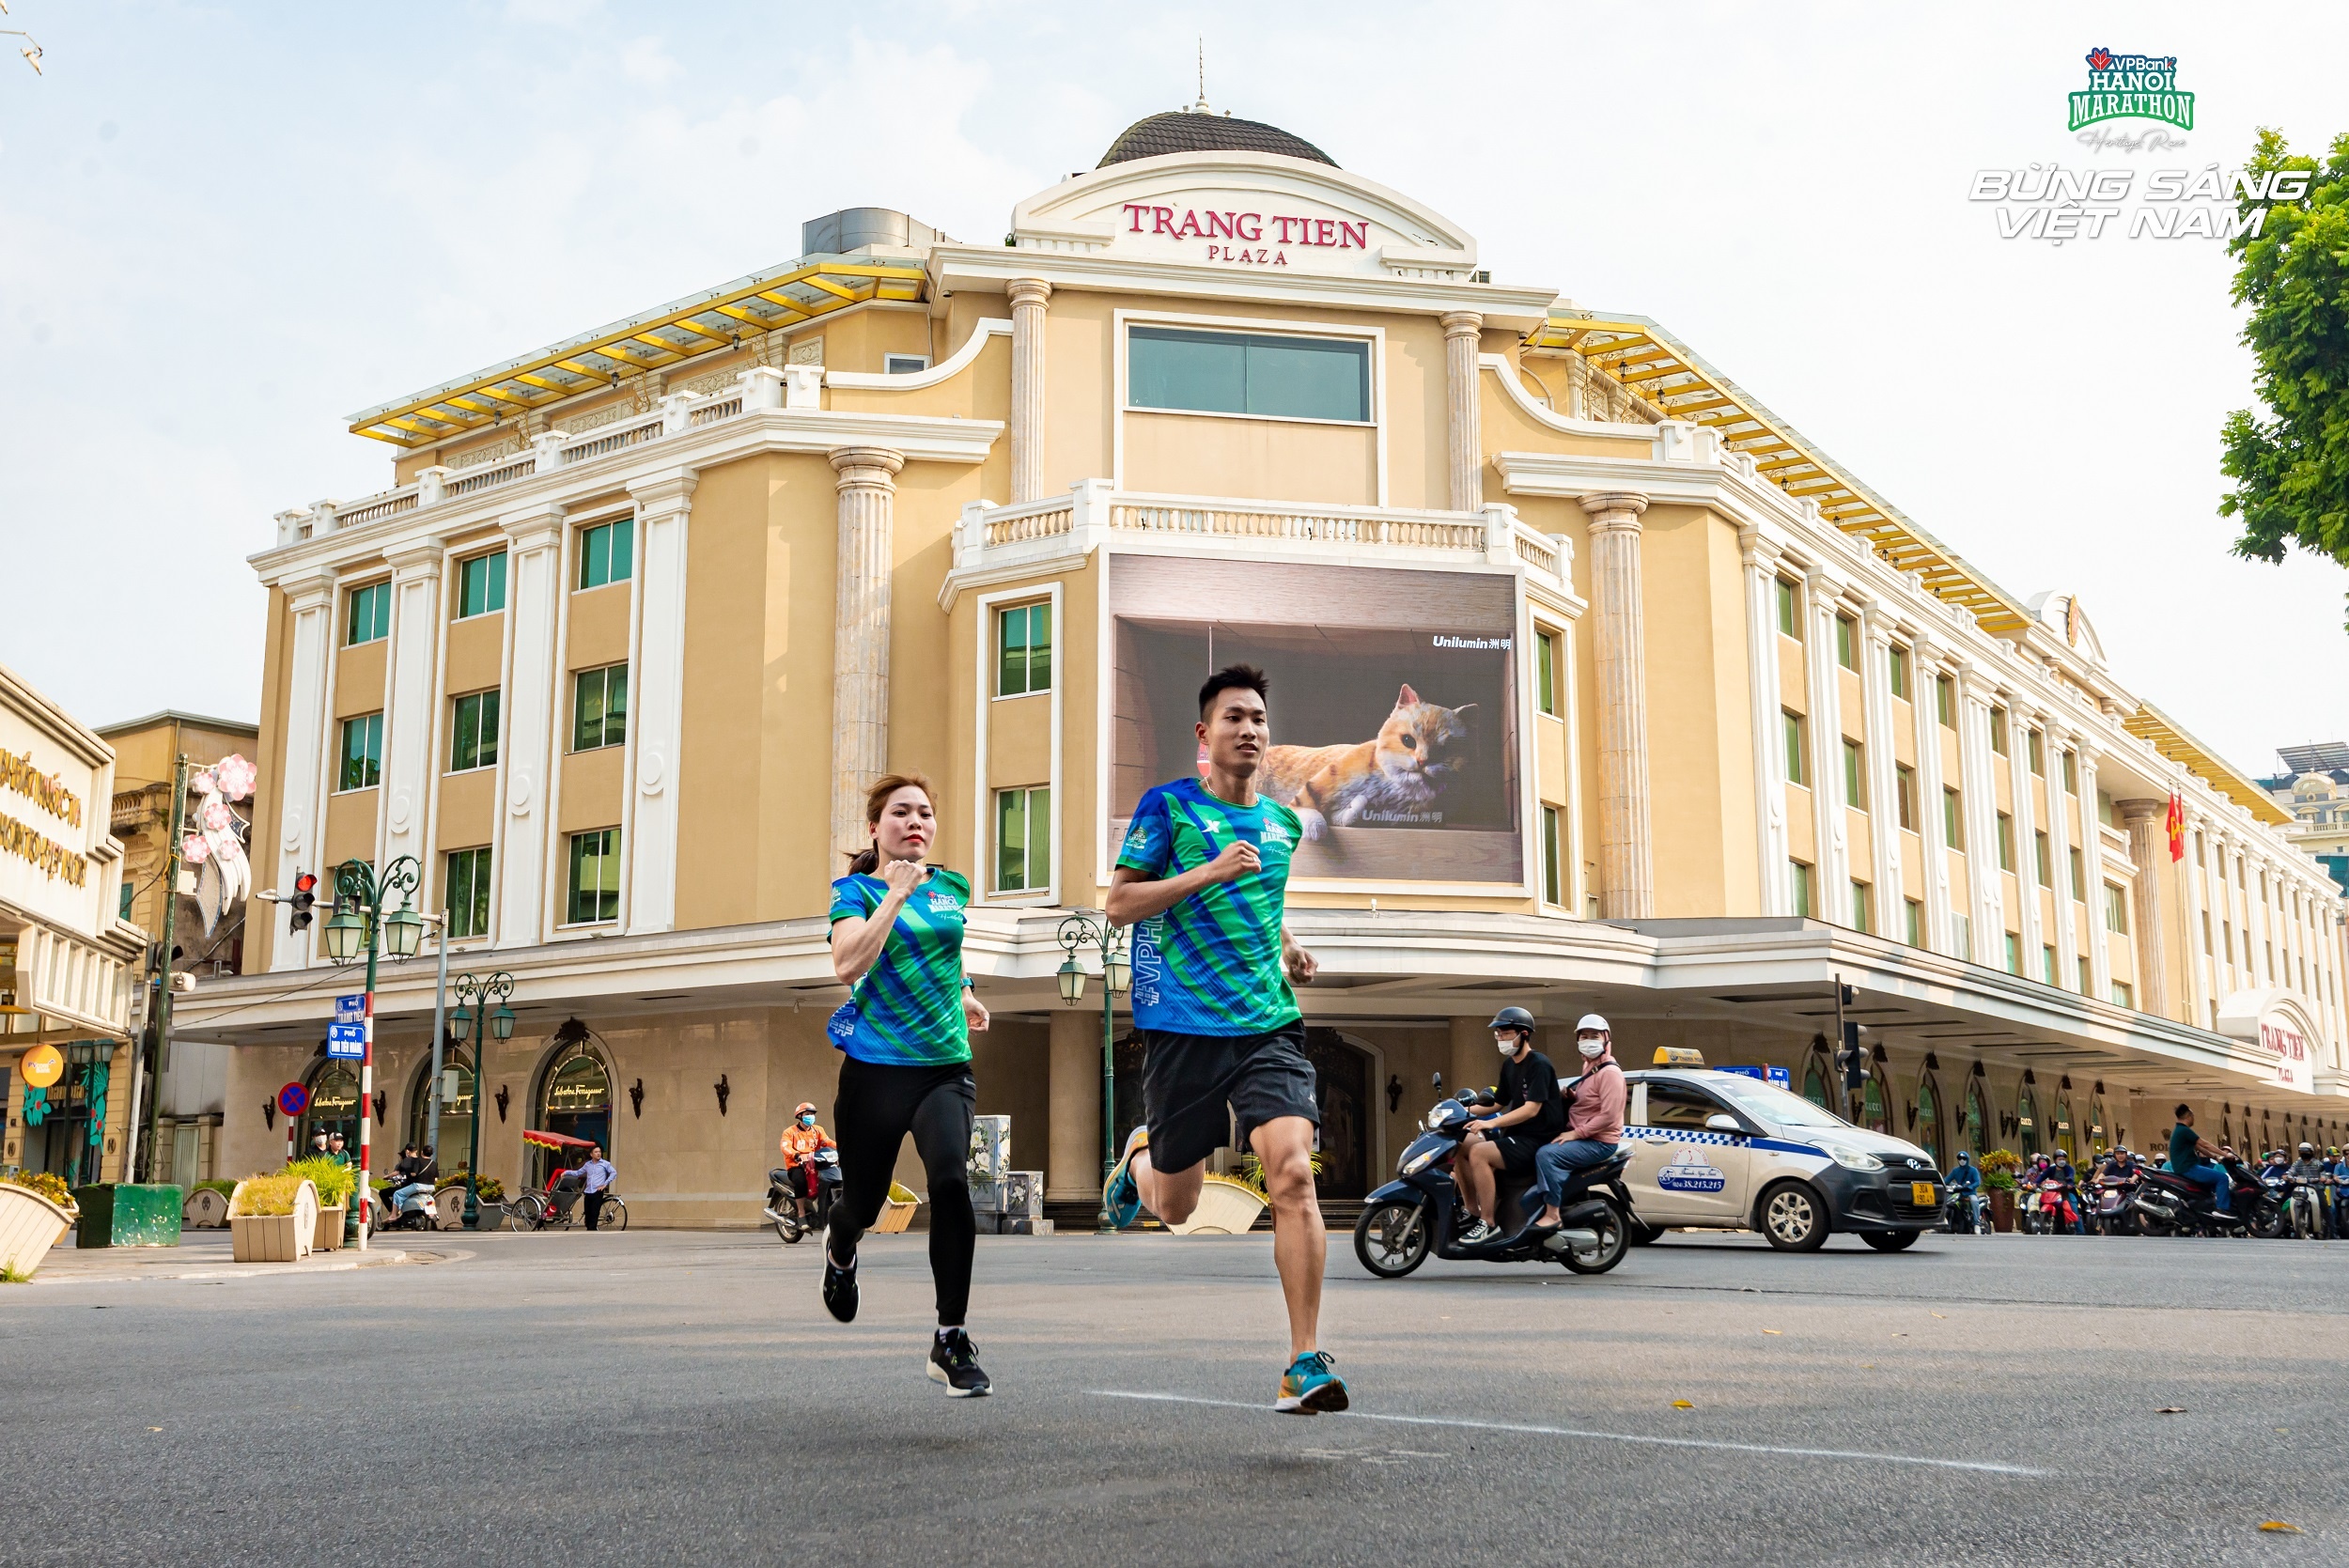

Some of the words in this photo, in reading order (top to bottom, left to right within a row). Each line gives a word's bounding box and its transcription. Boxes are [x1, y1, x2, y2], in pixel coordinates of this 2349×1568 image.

[1124, 203, 1263, 241] TRANG
[1272, 215, 1369, 249] TIEN
[1208, 244, 1288, 266] PLAZA
[1433, 635, 1487, 649] Unilumin
[1361, 809, 1419, 822] Unilumin
[2261, 1023, 2287, 1057] TRANG
[2286, 1032, 2304, 1062] TIEN
